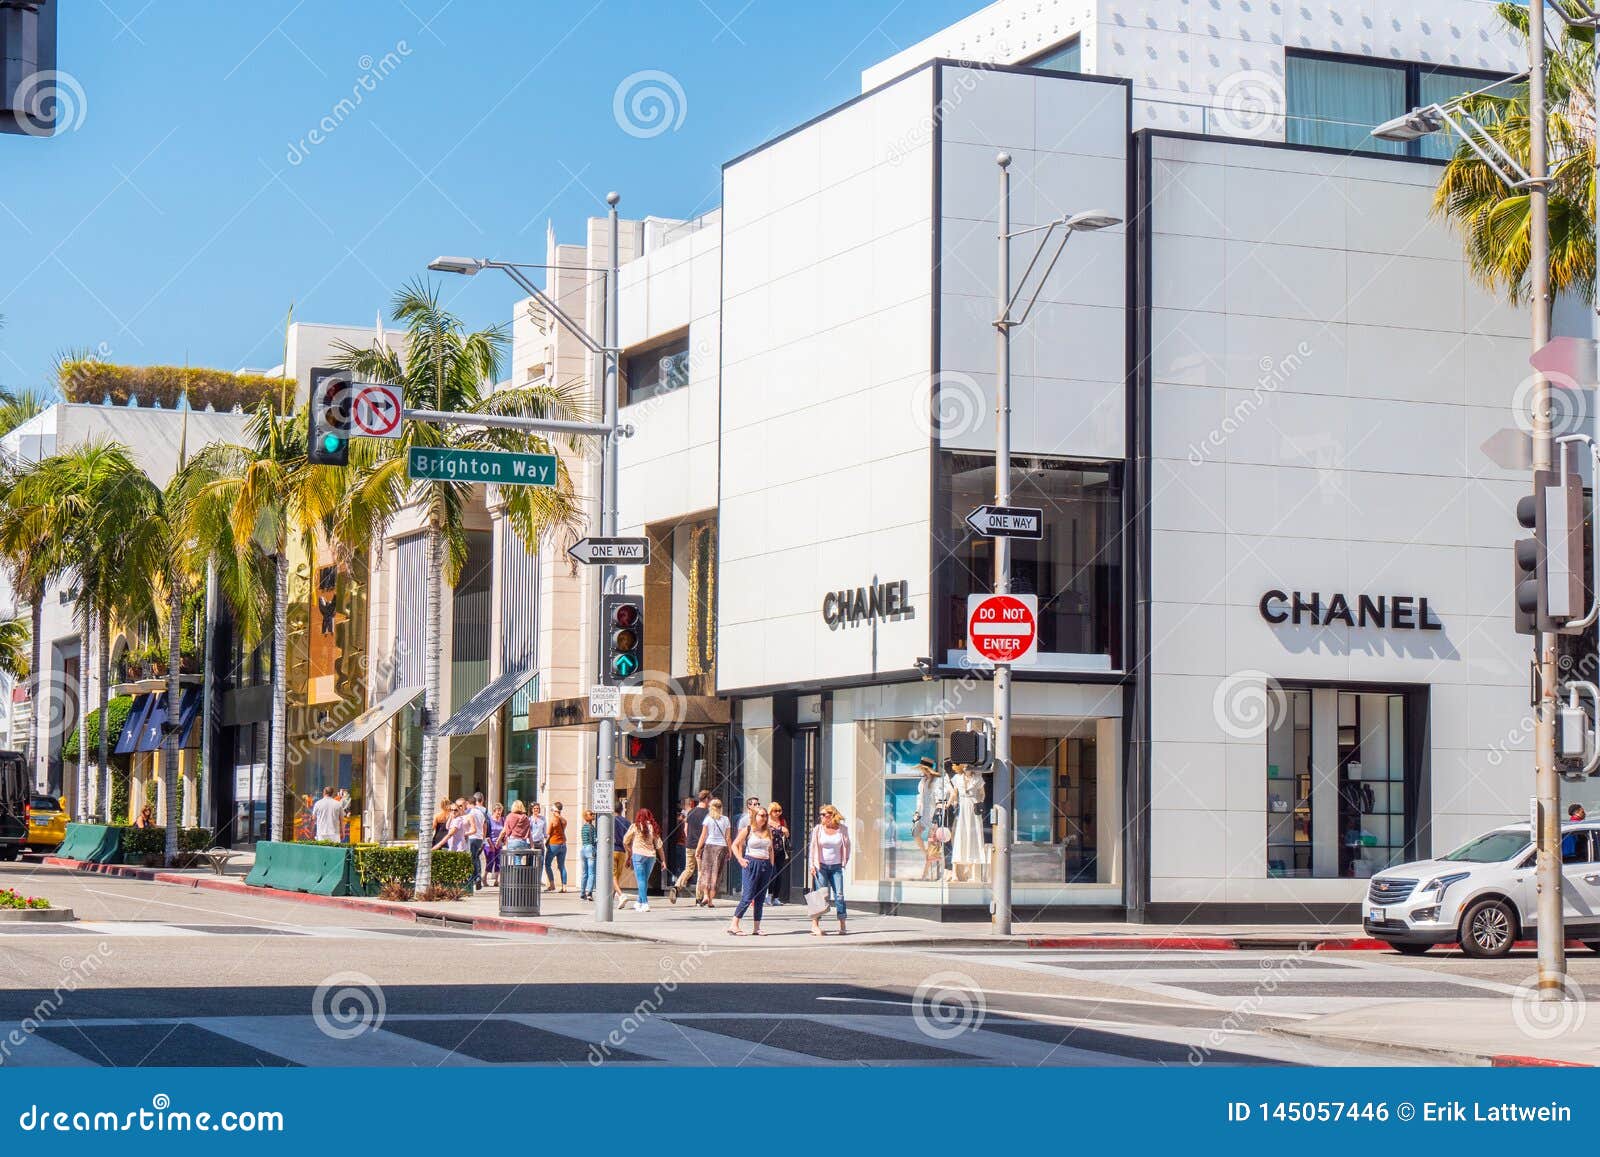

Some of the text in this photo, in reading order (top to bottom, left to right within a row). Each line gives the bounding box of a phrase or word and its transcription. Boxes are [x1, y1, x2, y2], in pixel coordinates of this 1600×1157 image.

[417, 455, 548, 481] Brighton Way
[989, 515, 1032, 529] ONE WAY
[591, 546, 639, 556] ONE WAY
[823, 580, 914, 624] CHANEL
[980, 608, 1025, 620] DO NOT
[1259, 589, 1442, 630] CHANEL
[983, 638, 1020, 650] ENTER
[592, 703, 604, 714] OK
